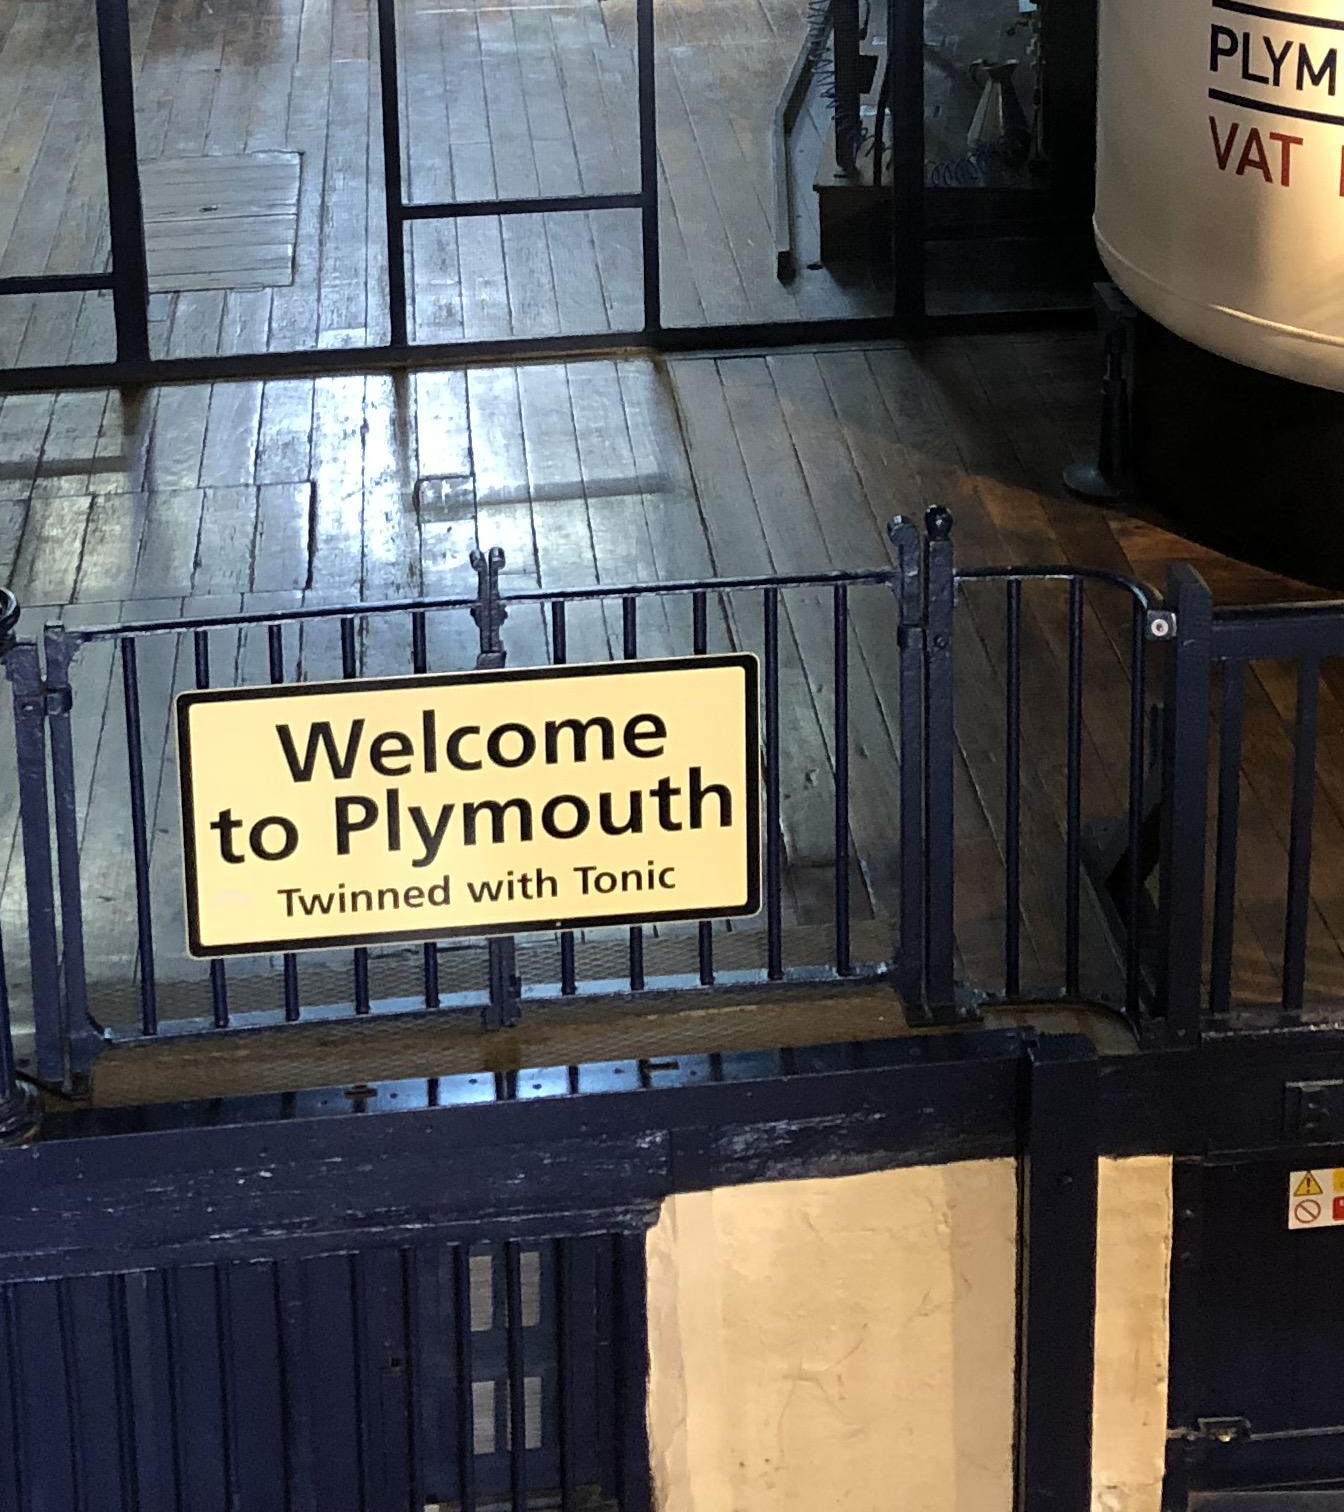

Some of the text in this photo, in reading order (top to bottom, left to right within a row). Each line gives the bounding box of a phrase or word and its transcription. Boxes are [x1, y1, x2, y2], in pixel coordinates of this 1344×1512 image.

[1207, 115, 1305, 189] VAT
[275, 708, 668, 783] Welcome
[209, 766, 733, 868] to Plymouth
[277, 860, 677, 918] Twinned with Tonic
